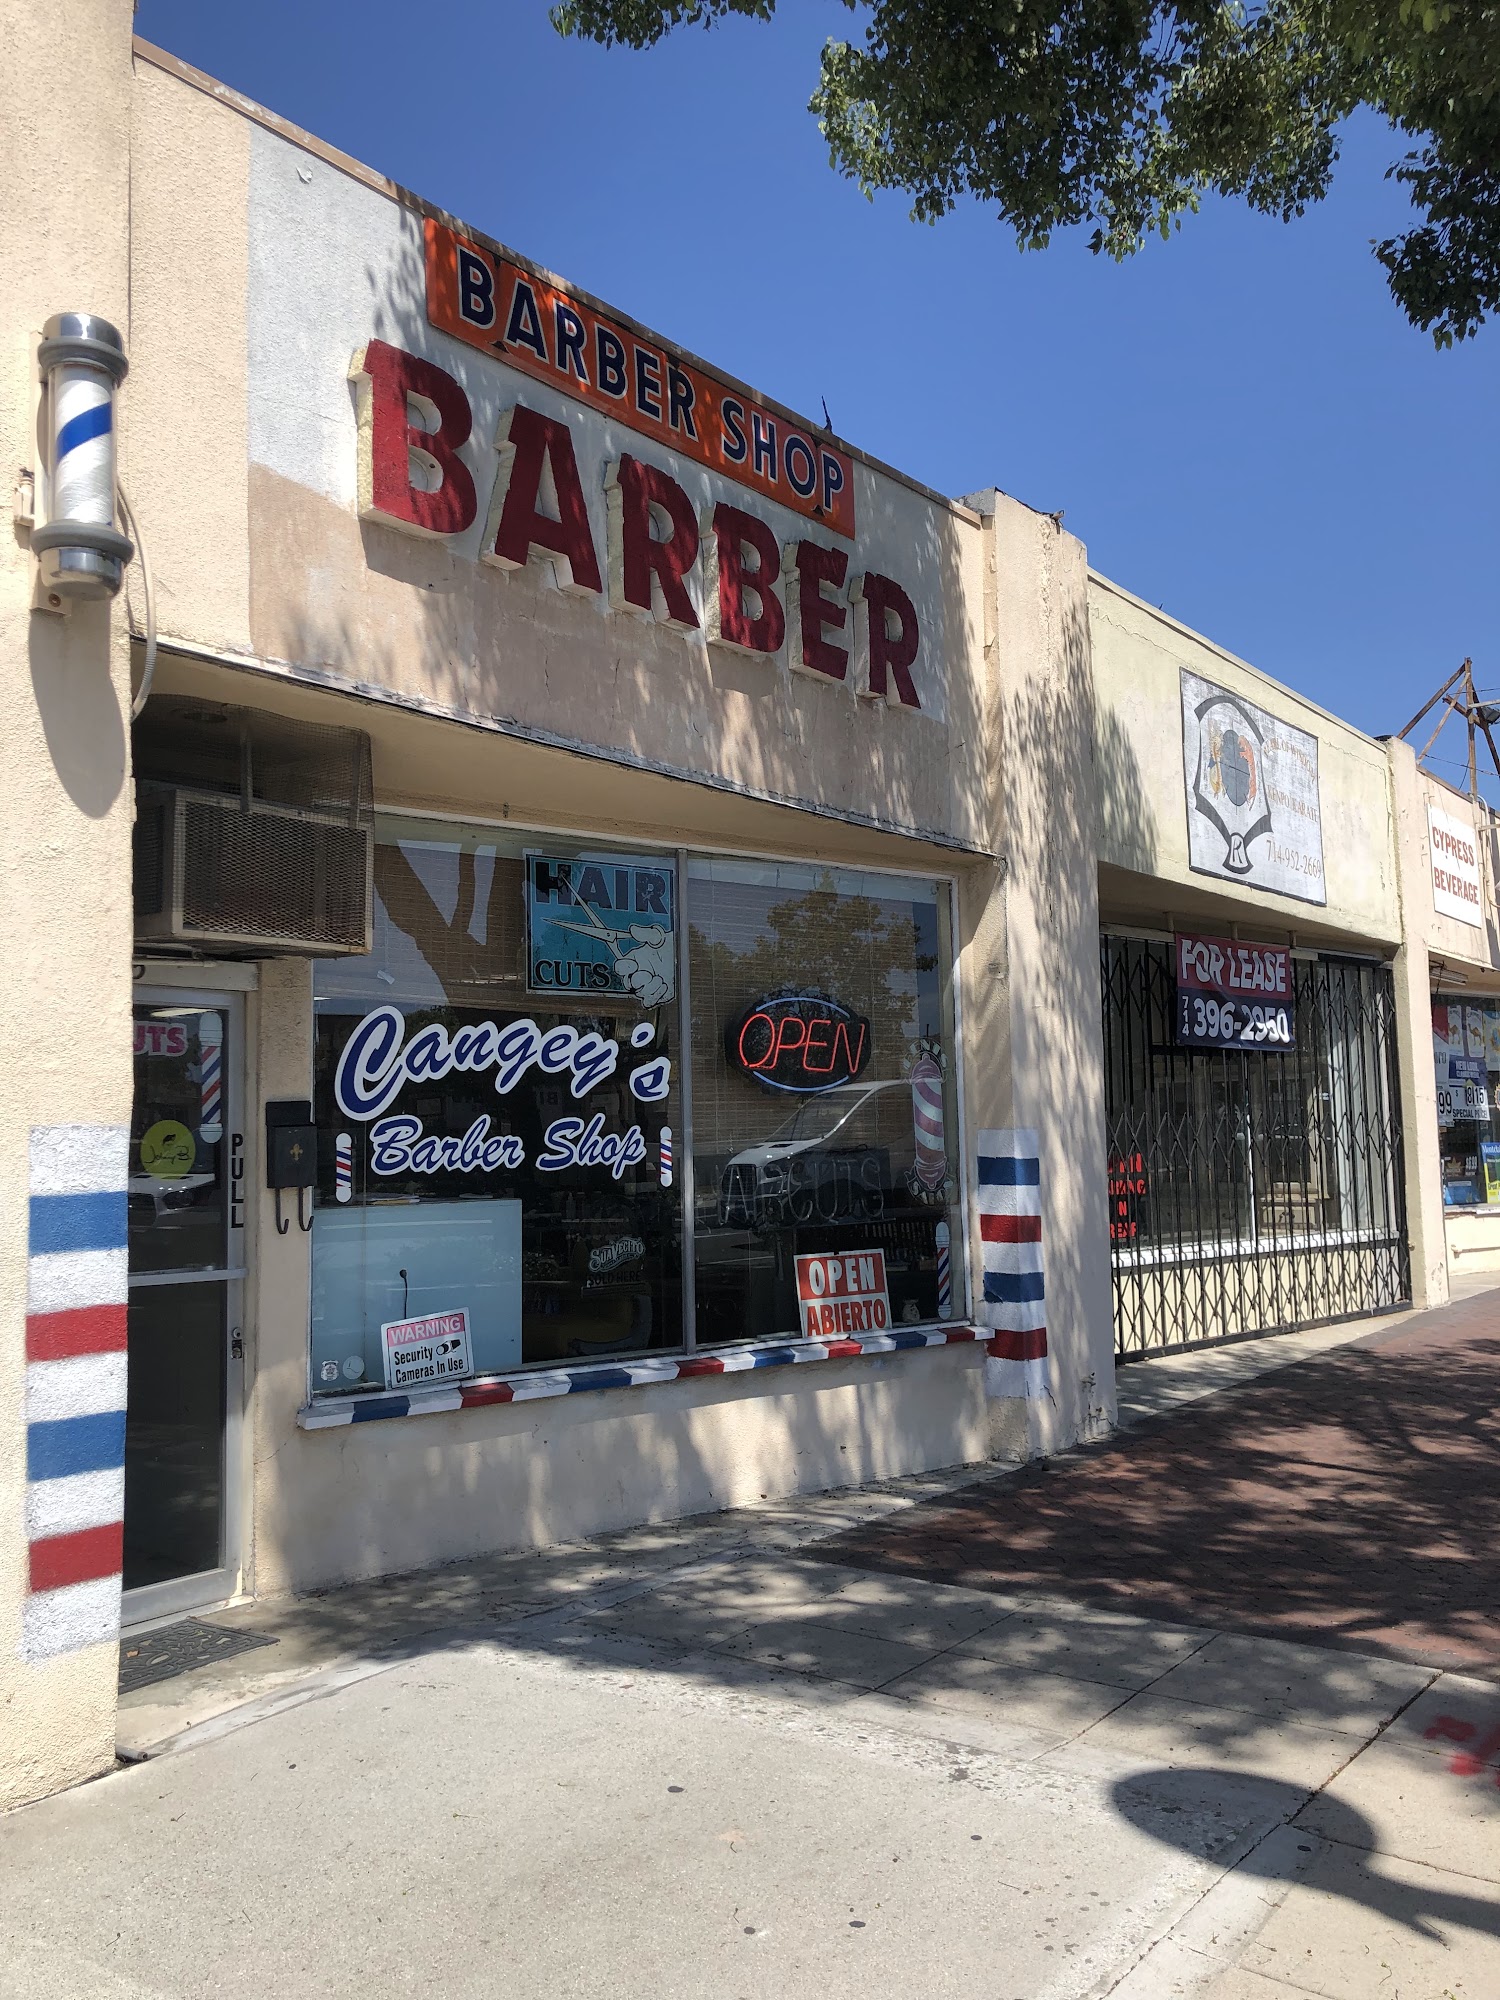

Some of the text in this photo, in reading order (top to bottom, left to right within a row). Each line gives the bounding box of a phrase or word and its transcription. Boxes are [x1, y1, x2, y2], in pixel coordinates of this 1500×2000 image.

[457, 245, 845, 512] BARBER SHOP
[356, 339, 921, 709] BARBER
[1432, 826, 1475, 867] CYPRESS
[534, 860, 670, 915] HAIR
[1434, 866, 1479, 905] BEVERAGE
[534, 960, 611, 987] CUTS
[1181, 939, 1286, 992] FOR LEASE
[1193, 998, 1290, 1043] 396-2950
[334, 1006, 671, 1121] Cangey's
[739, 1013, 865, 1074] OPEN
[1452, 1108, 1474, 1119] SPECIAL
[371, 1113, 647, 1180] Barber Shop
[231, 1133, 244, 1228] PULL
[589, 1239, 645, 1272] SUAVECITO
[808, 1257, 877, 1295] OPEN
[391, 1317, 461, 1344] WARNING
[807, 1298, 888, 1337] ABIERTO
[394, 1346, 433, 1366] Security
[395, 1358, 464, 1384] Cameras In Use
